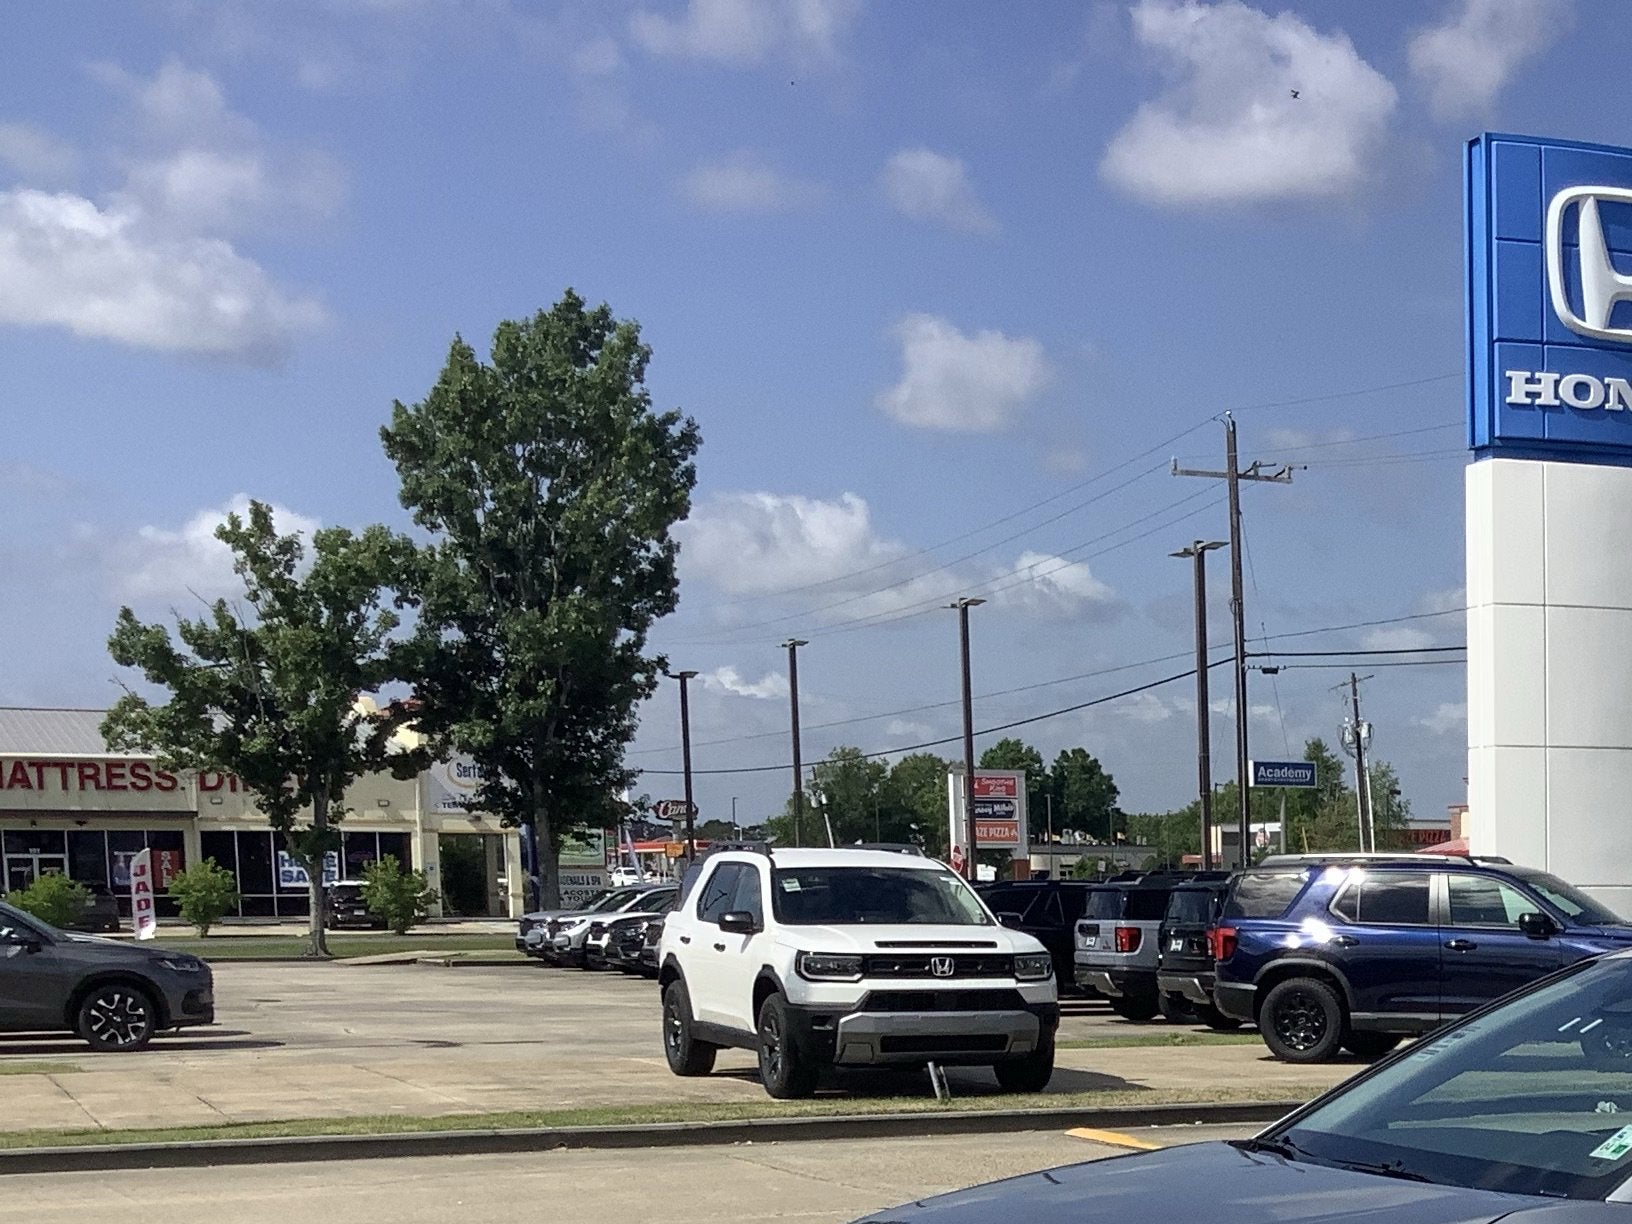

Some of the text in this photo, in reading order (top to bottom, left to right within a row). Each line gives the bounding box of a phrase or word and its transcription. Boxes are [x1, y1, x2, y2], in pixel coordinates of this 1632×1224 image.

[0, 760, 178, 792] ATTRESS
[1257, 766, 1312, 781] Academy
[989, 827, 1009, 838] PIZZA
